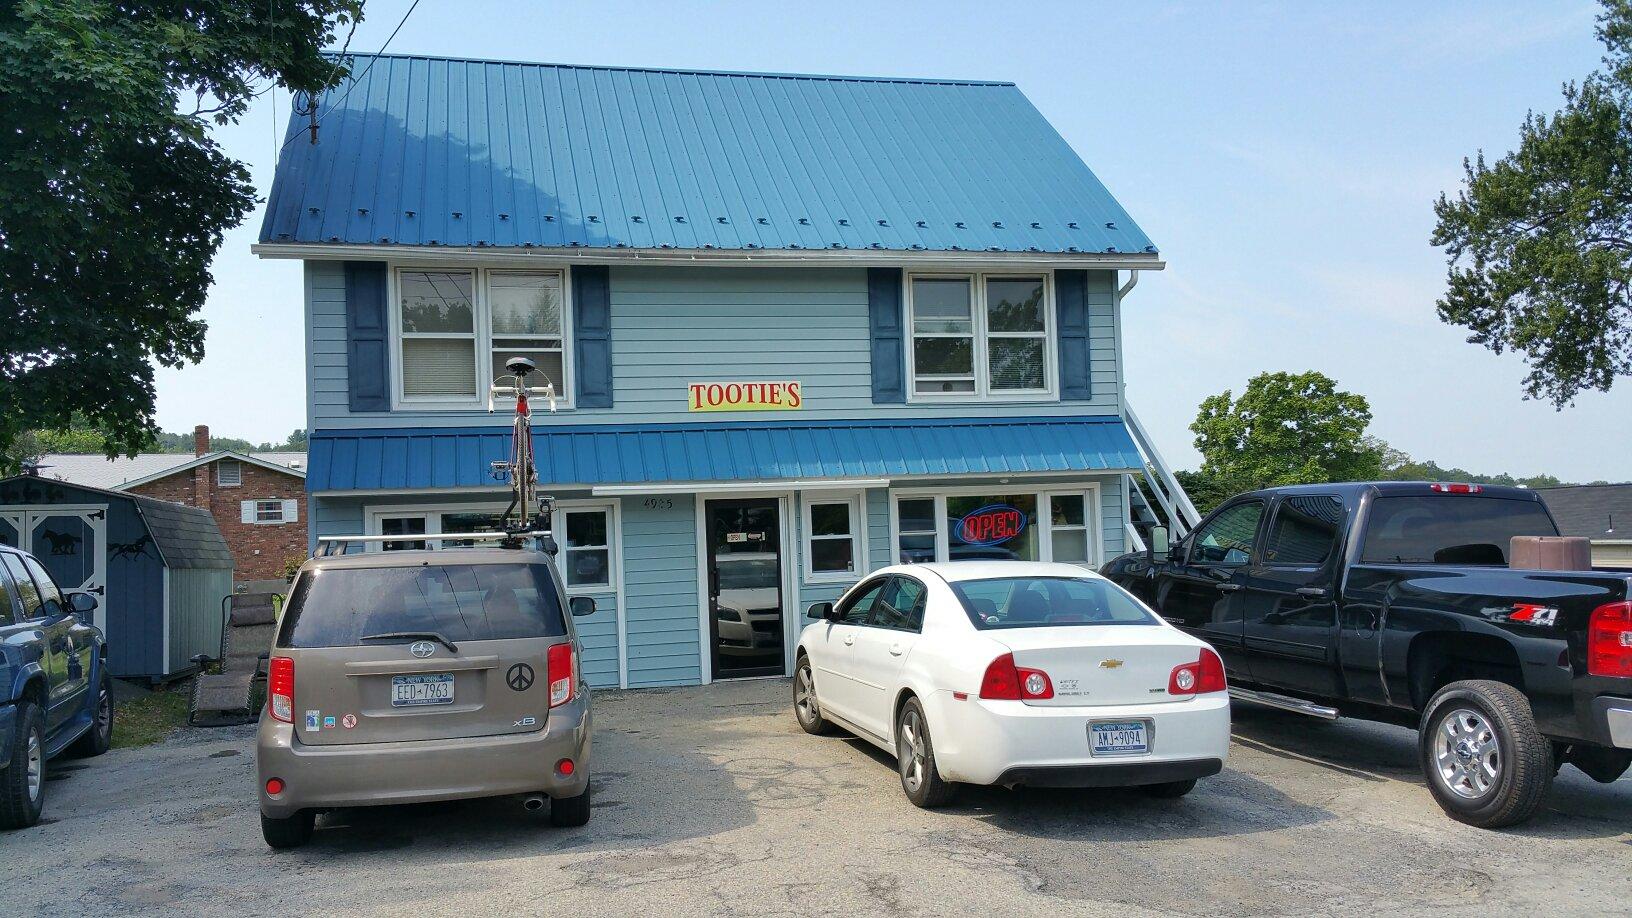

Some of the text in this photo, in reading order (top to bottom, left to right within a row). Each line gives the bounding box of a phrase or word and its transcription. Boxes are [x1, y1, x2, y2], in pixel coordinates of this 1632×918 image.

[690, 382, 800, 409] TOOTIE'S
[962, 511, 1019, 541] OPEN
[512, 717, 536, 727] xB
